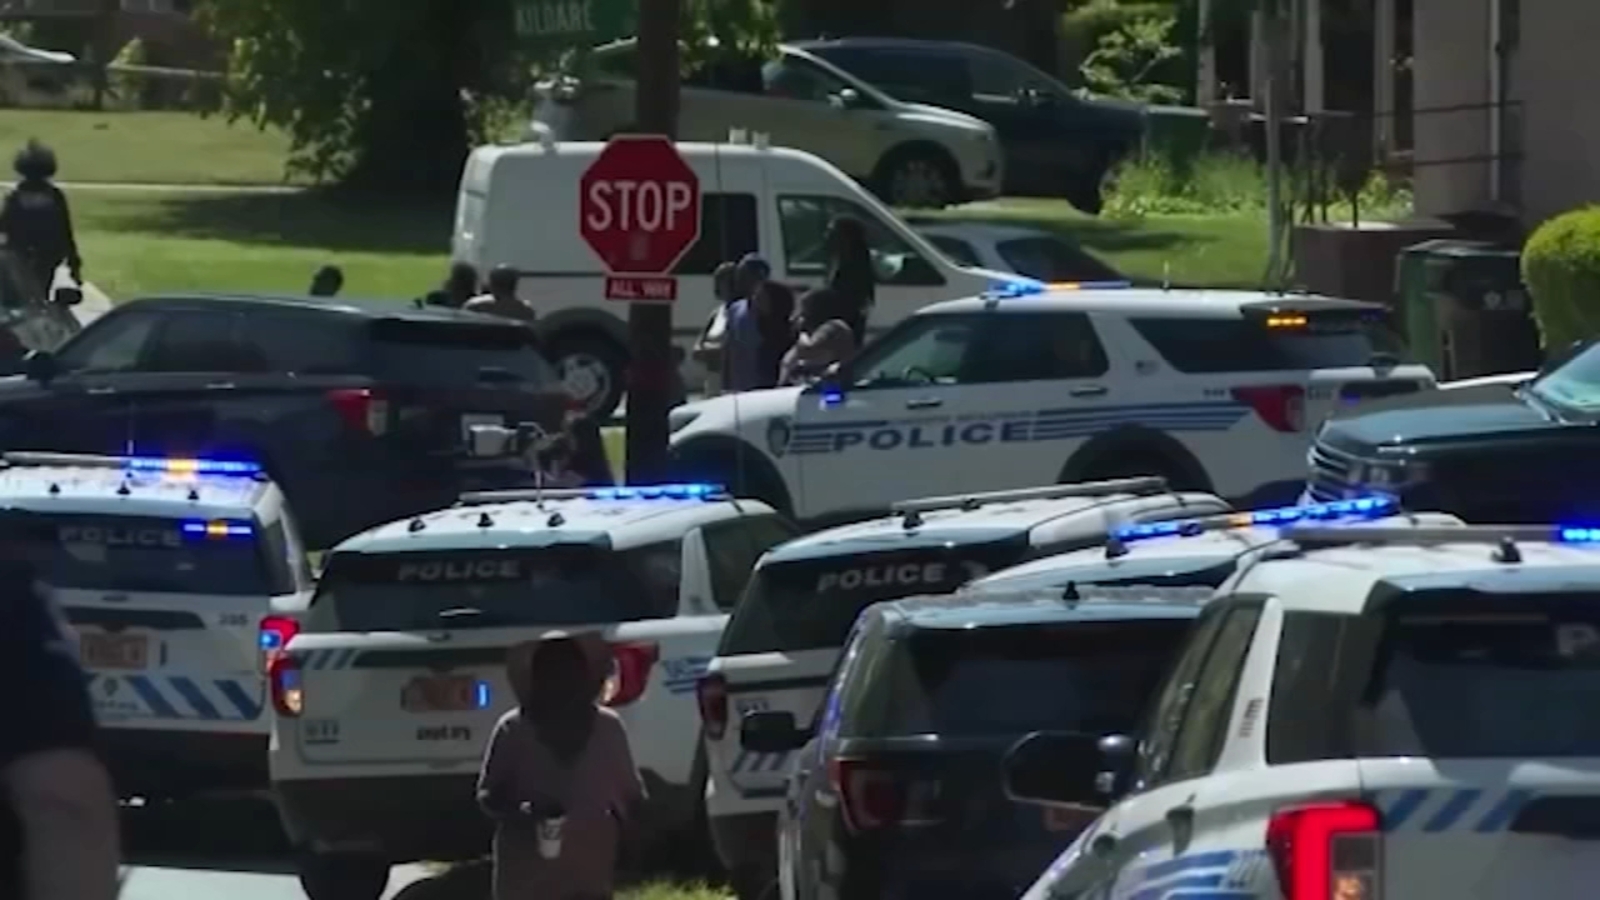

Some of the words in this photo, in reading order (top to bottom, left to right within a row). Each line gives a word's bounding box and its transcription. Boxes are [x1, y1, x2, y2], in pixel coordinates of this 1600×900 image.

[587, 180, 691, 231] STOP
[610, 280, 638, 296] ALL
[833, 421, 1032, 450] POLICE
[58, 527, 181, 546] POLICE
[398, 559, 521, 580] POLICE
[817, 562, 946, 592] POLICE
